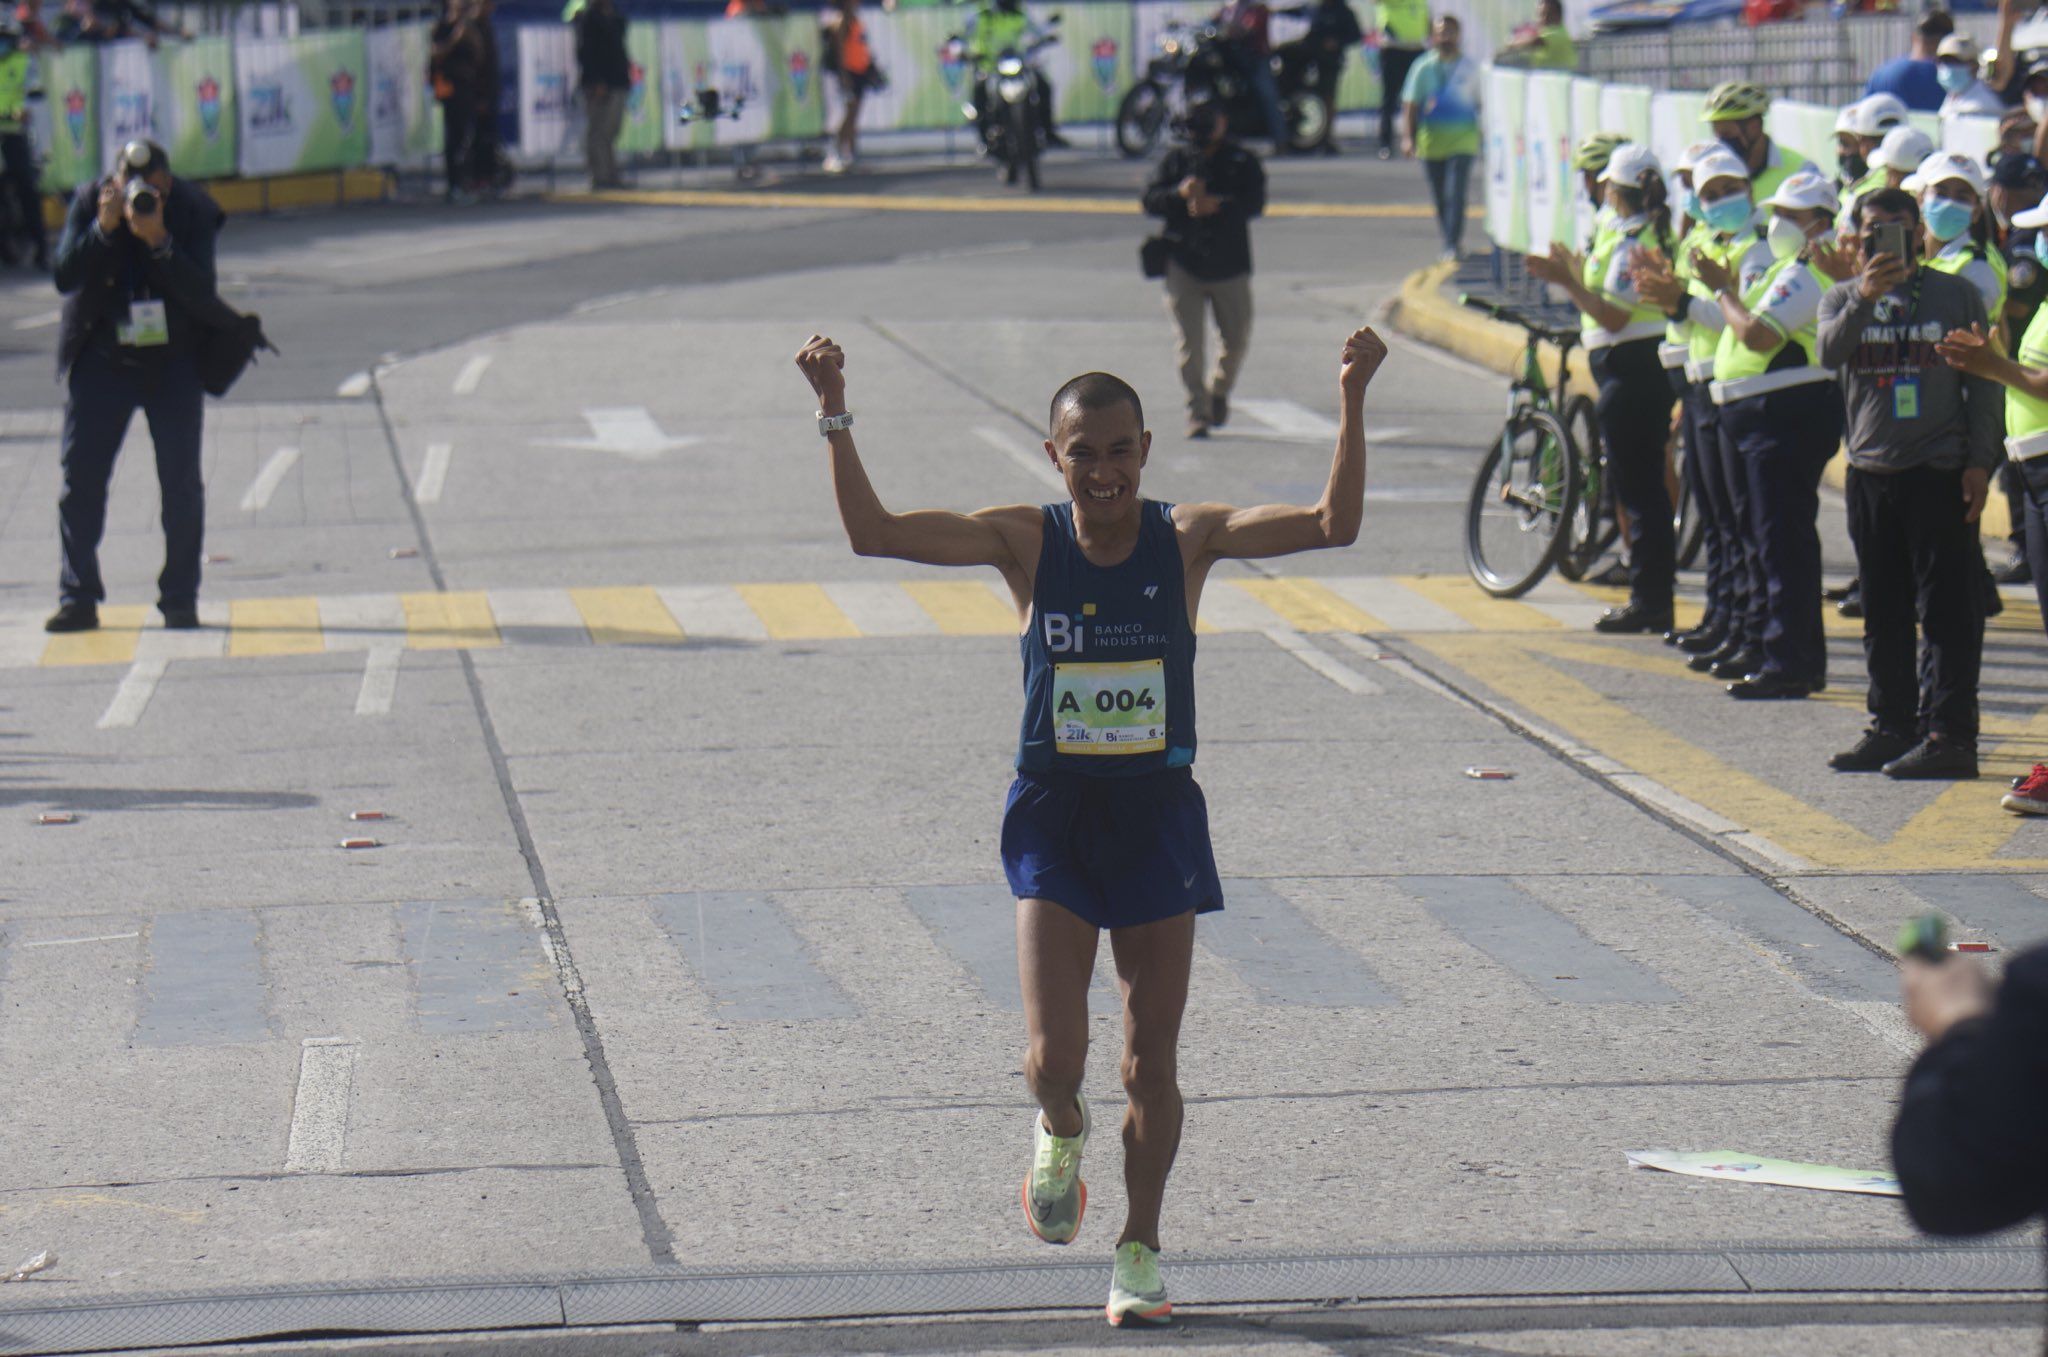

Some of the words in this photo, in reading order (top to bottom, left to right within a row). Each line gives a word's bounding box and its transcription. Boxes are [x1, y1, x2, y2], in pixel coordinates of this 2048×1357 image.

[1044, 613, 1083, 652] Bi
[1095, 623, 1142, 635] BANCO
[1057, 691, 1081, 713] A
[1096, 688, 1155, 712] 004
